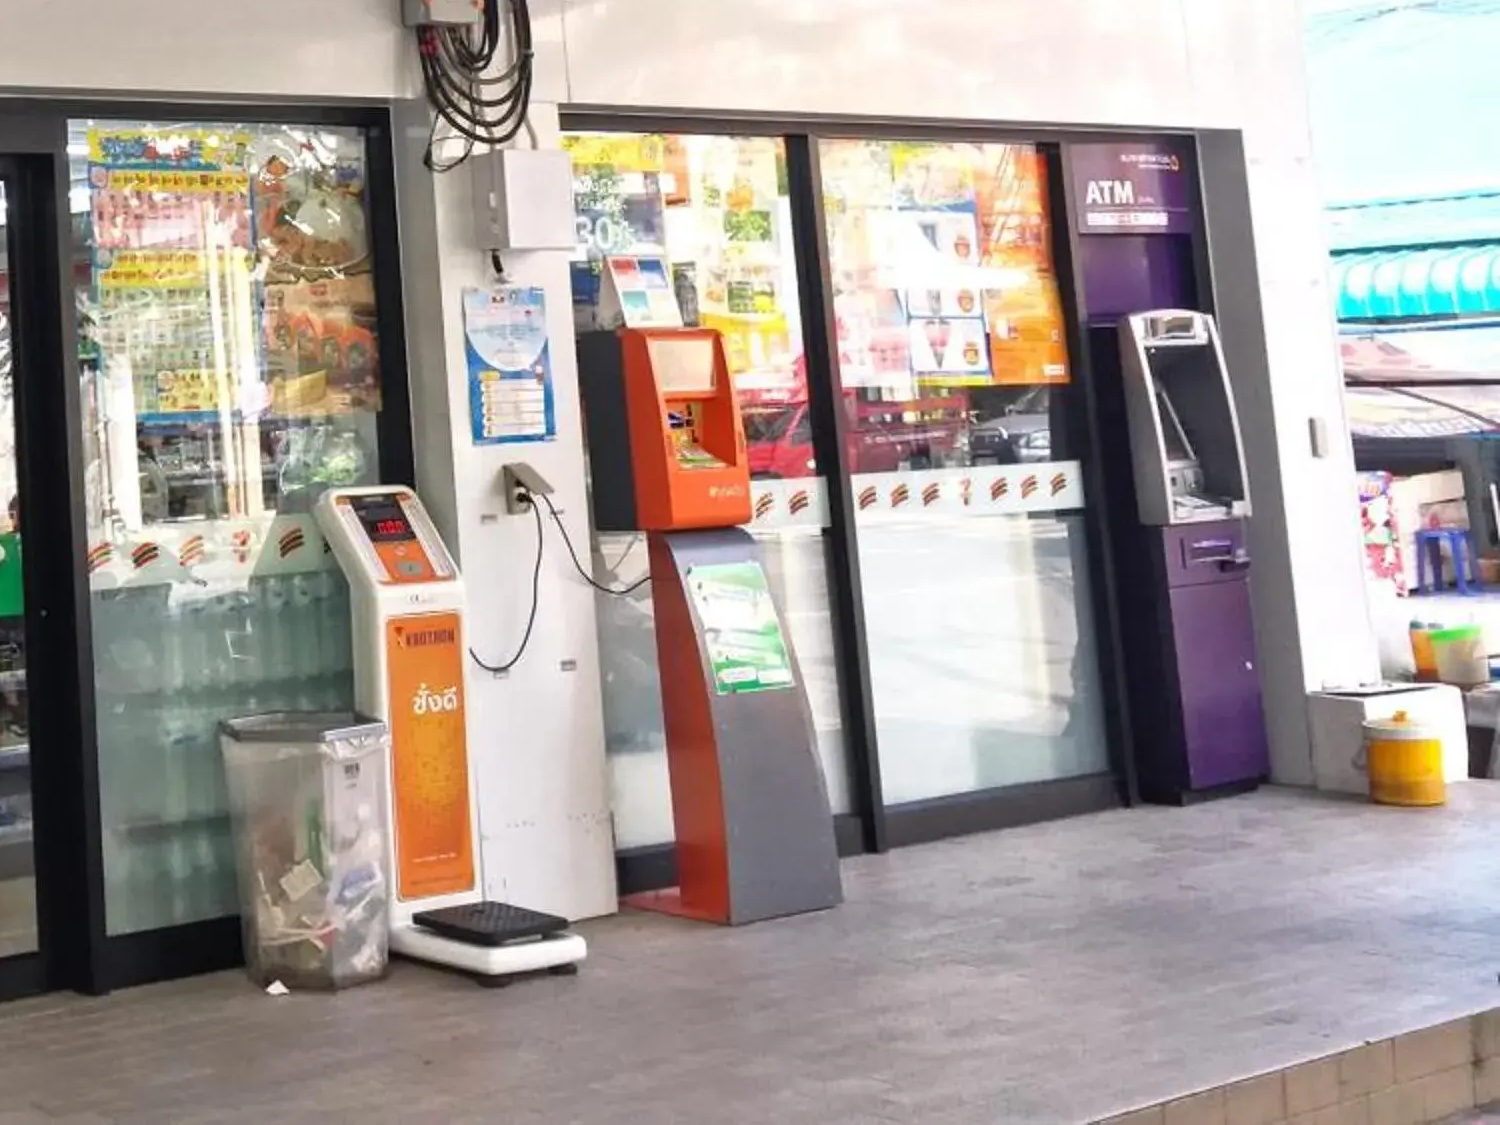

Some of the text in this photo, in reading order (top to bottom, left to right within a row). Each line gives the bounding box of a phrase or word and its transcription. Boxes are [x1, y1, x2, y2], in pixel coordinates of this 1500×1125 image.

[1086, 179, 1135, 205] ATM
[412, 682, 458, 715] ชั่งดี
